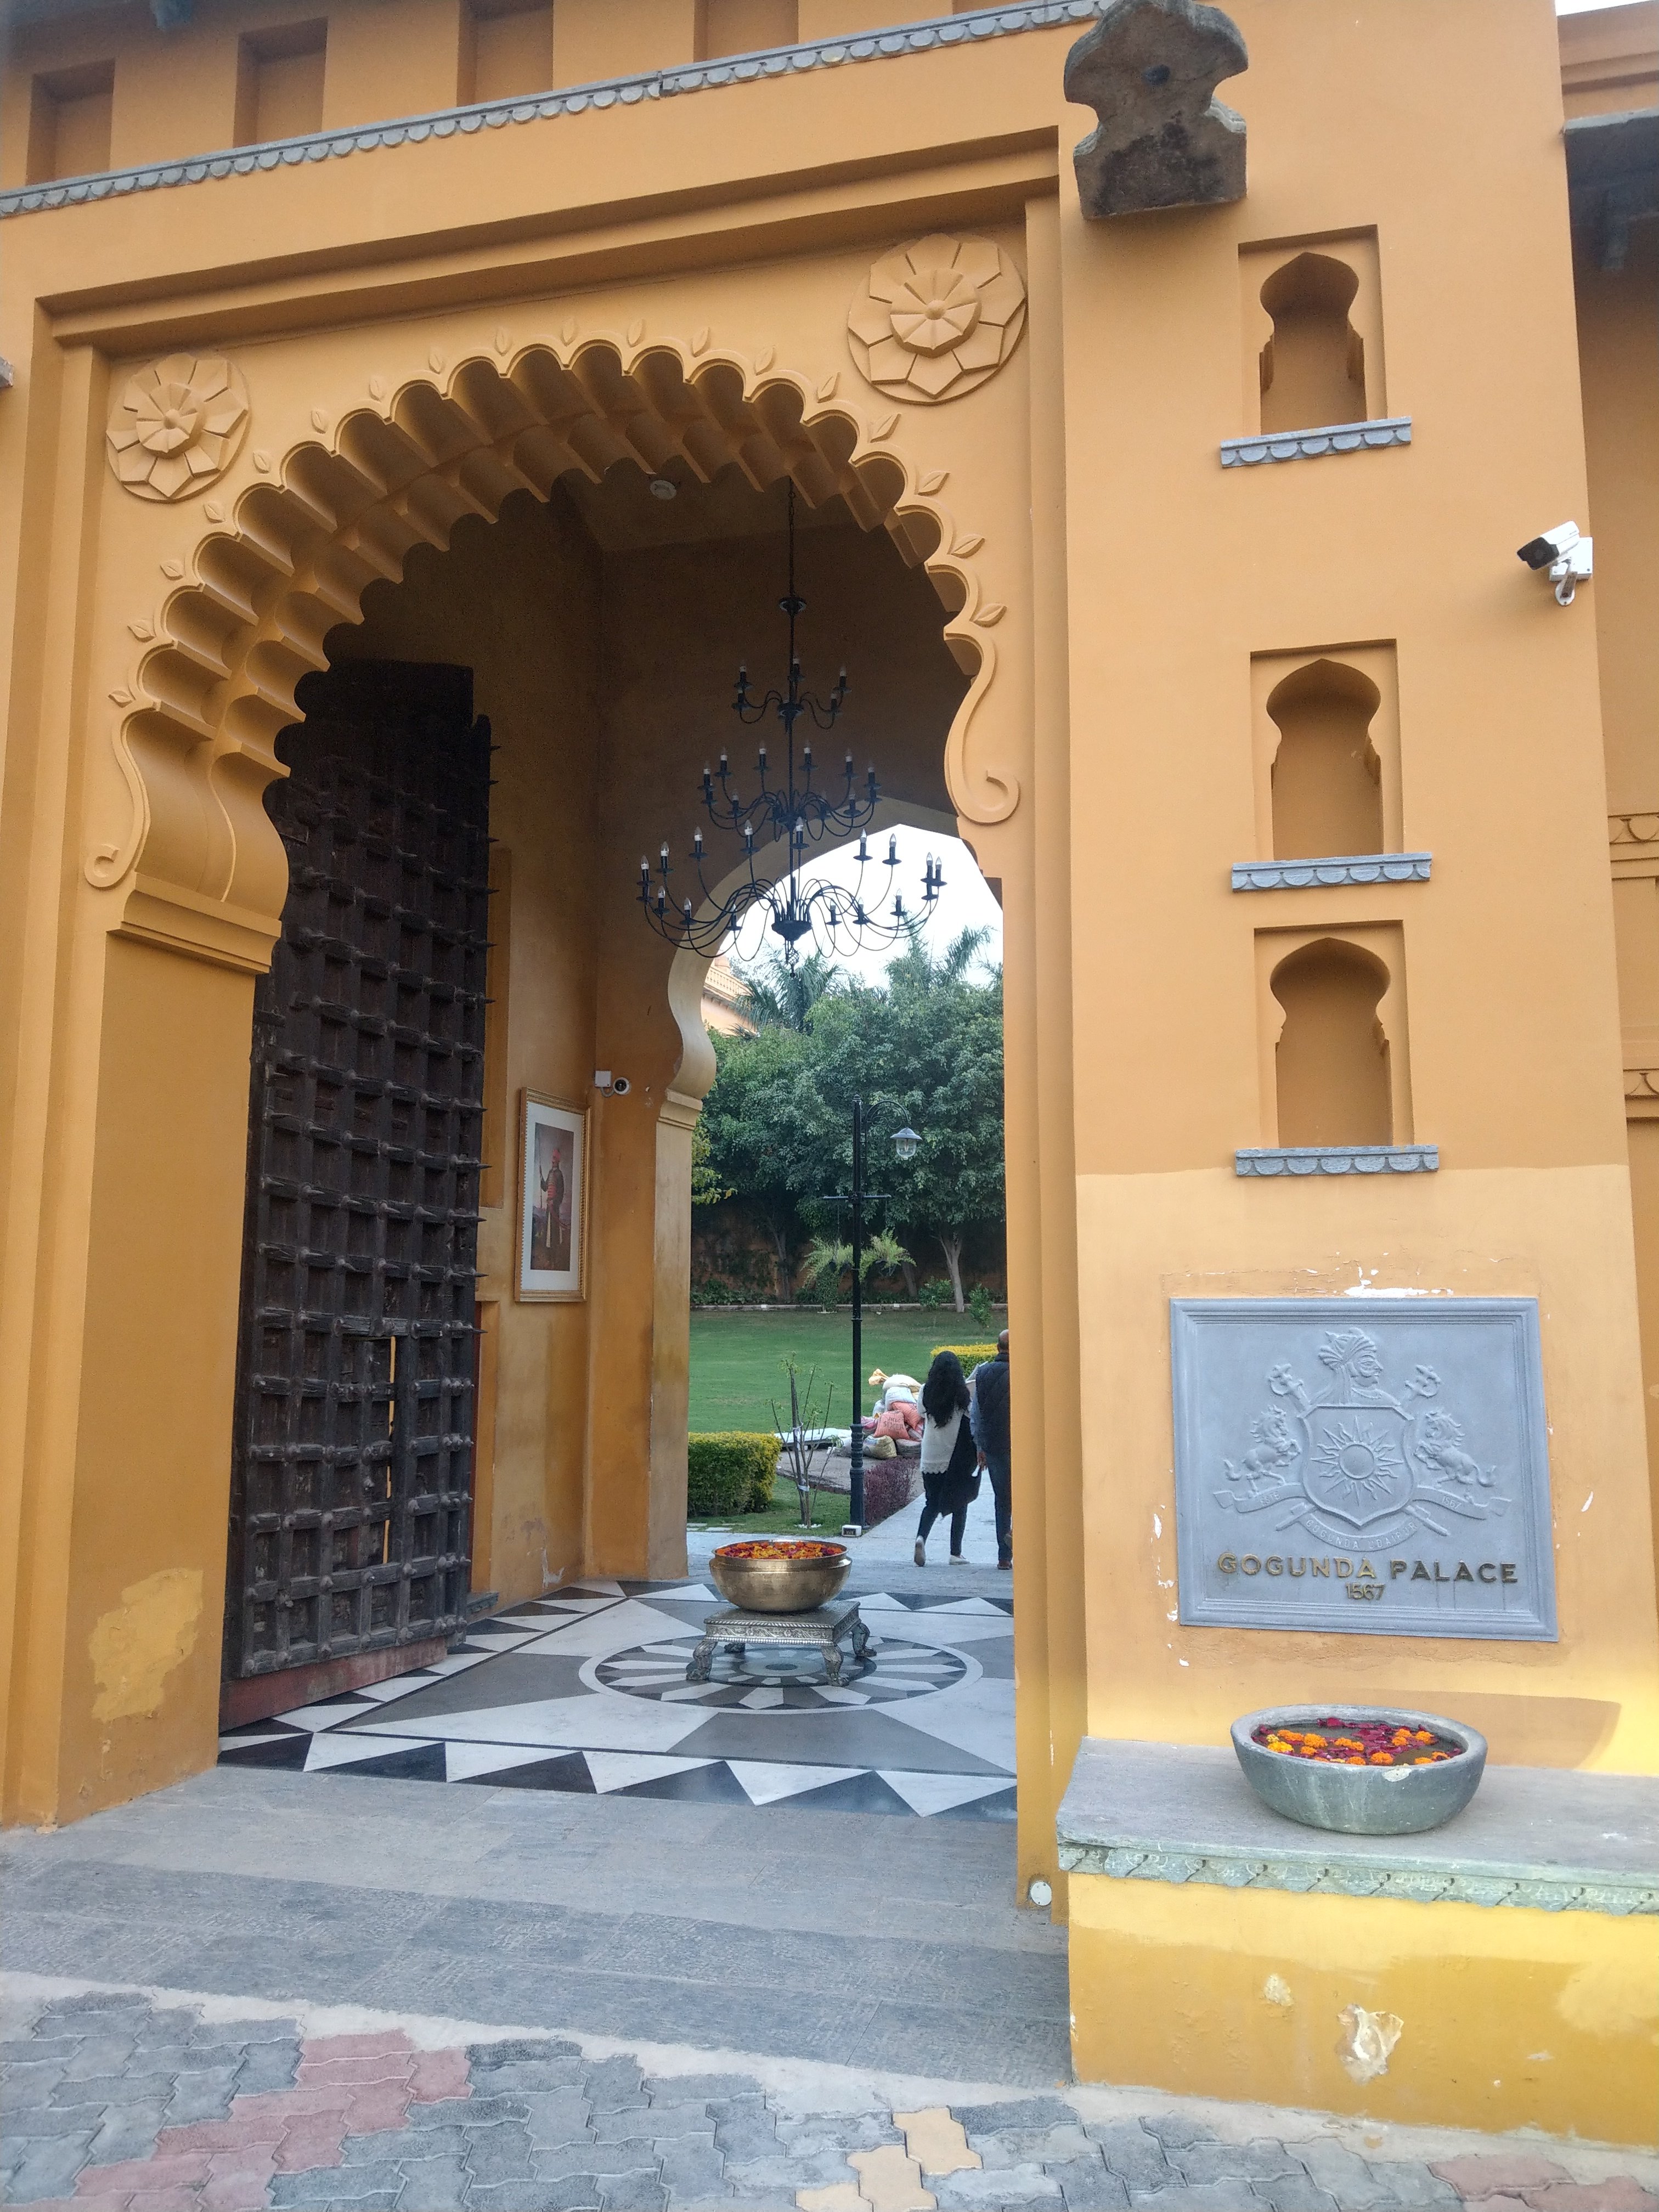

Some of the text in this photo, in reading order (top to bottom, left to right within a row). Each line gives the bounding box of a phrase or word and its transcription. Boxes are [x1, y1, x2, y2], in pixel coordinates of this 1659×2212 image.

[1306, 1519, 1418, 1549] GOGUNDA UDAIPUR
[1218, 1552, 1518, 1583] GOGUNDA PALACE
[1346, 1583, 1385, 1600] 1567
